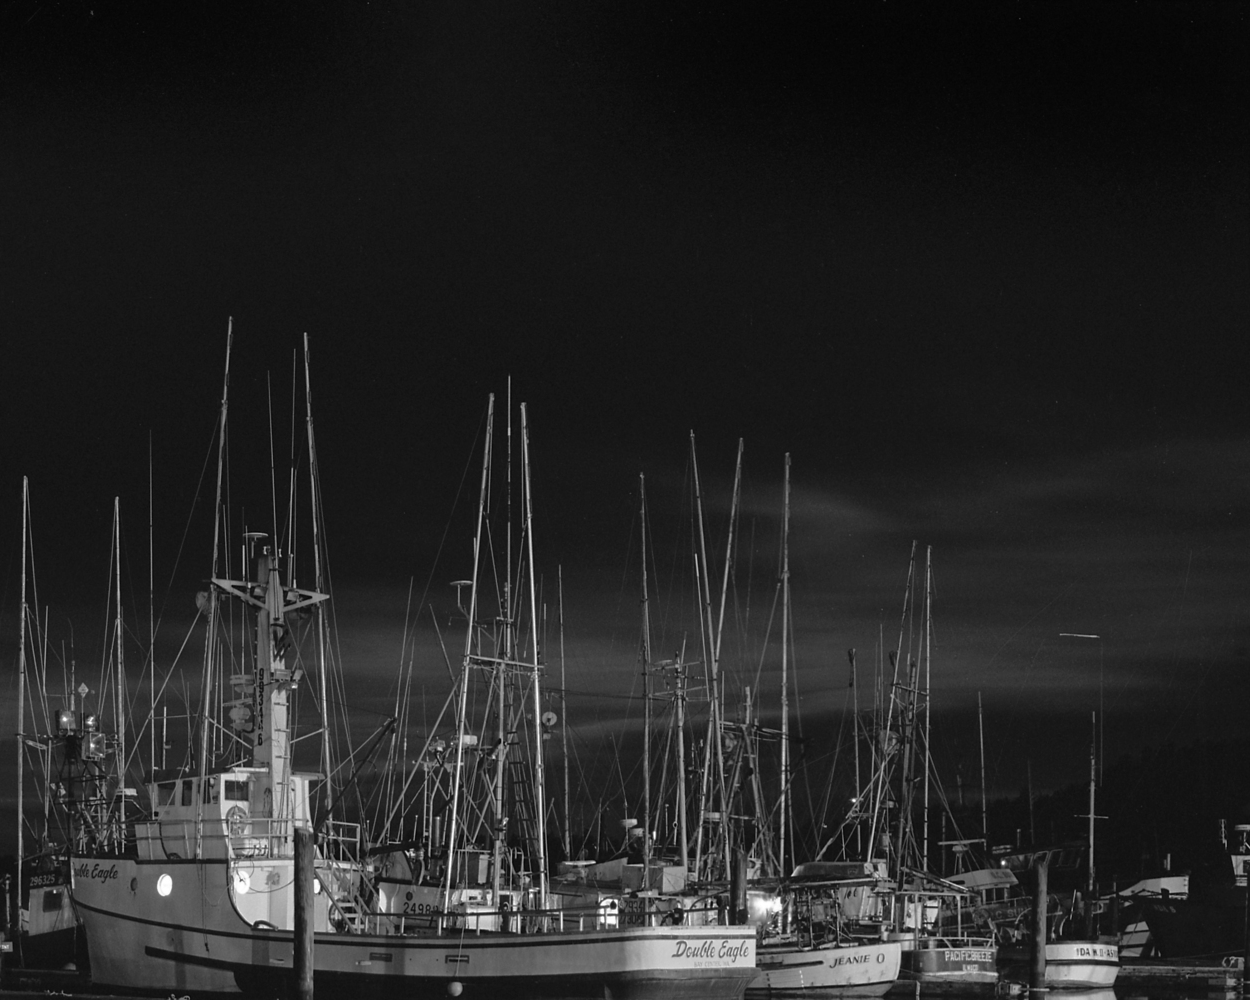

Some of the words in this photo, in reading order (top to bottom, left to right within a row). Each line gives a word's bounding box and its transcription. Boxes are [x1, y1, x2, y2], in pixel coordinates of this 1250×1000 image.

[29, 874, 56, 887] 296325
[91, 863, 119, 883] Eagle
[671, 940, 716, 958] Double
[718, 940, 749, 963] Eagle
[1076, 947, 1091, 957] IDA
[829, 954, 871, 969] JEANIE
[876, 953, 886, 964] O
